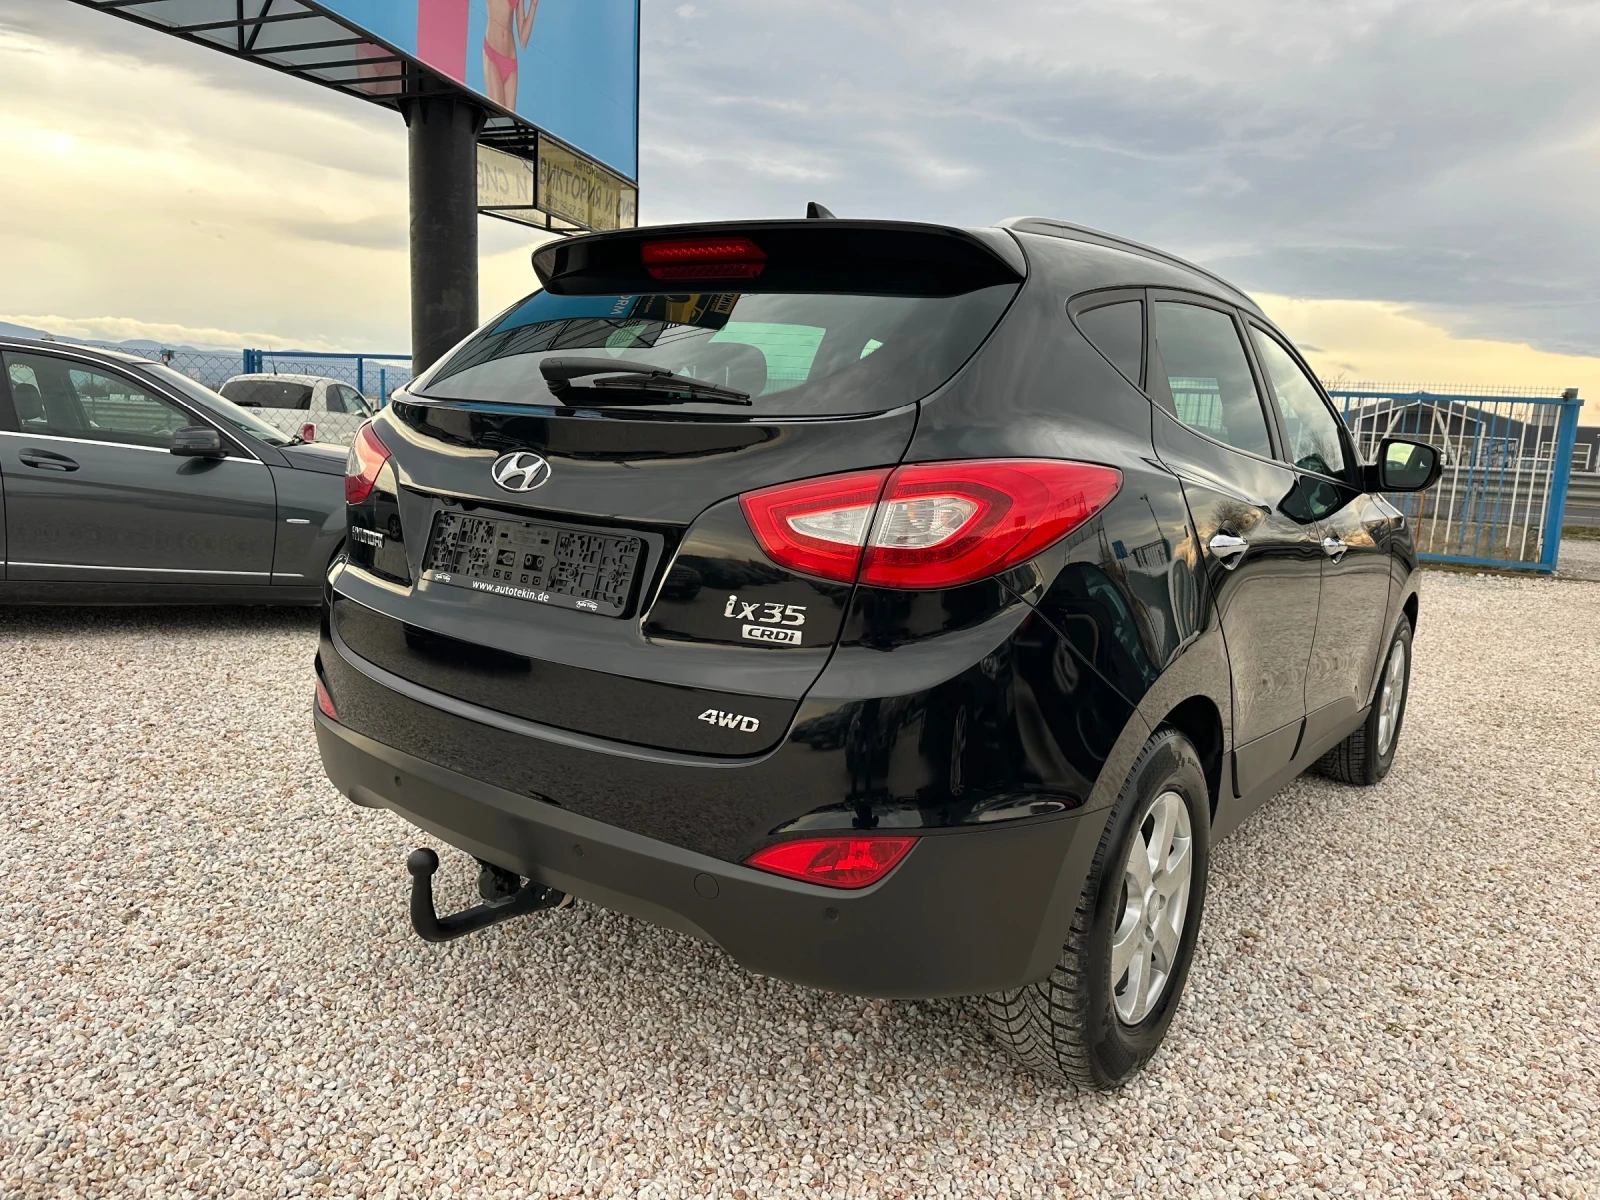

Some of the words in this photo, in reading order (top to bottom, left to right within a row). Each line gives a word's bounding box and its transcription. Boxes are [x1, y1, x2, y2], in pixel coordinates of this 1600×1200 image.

[539, 157, 602, 209] ВИКТОРИЯ
[472, 580, 550, 602] www.autotekin.de
[724, 595, 807, 626] ix35
[748, 628, 796, 642] CRDi
[698, 709, 760, 732] 4WD
